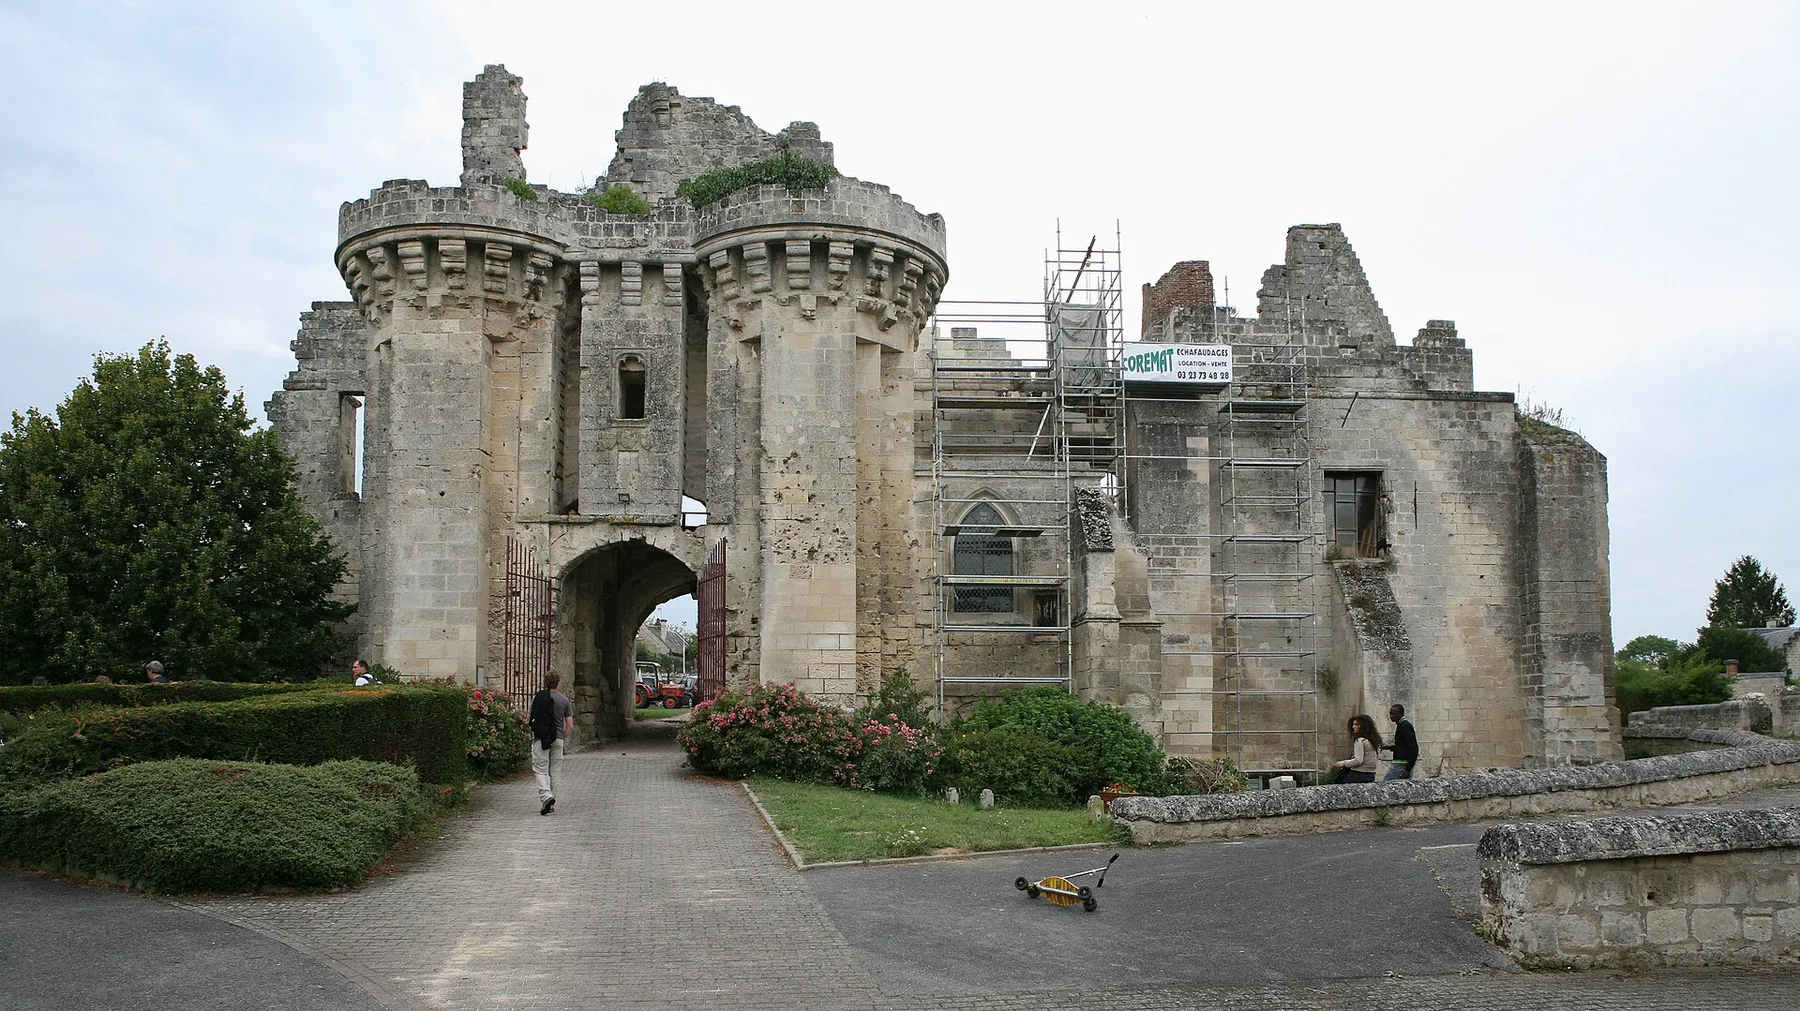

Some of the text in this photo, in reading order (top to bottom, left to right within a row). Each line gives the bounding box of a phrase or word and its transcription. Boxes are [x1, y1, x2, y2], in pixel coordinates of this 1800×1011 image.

[1176, 348, 1229, 357] ECHAFAUDAGES
[1177, 371, 1230, 380] 03 23 73 48 28
